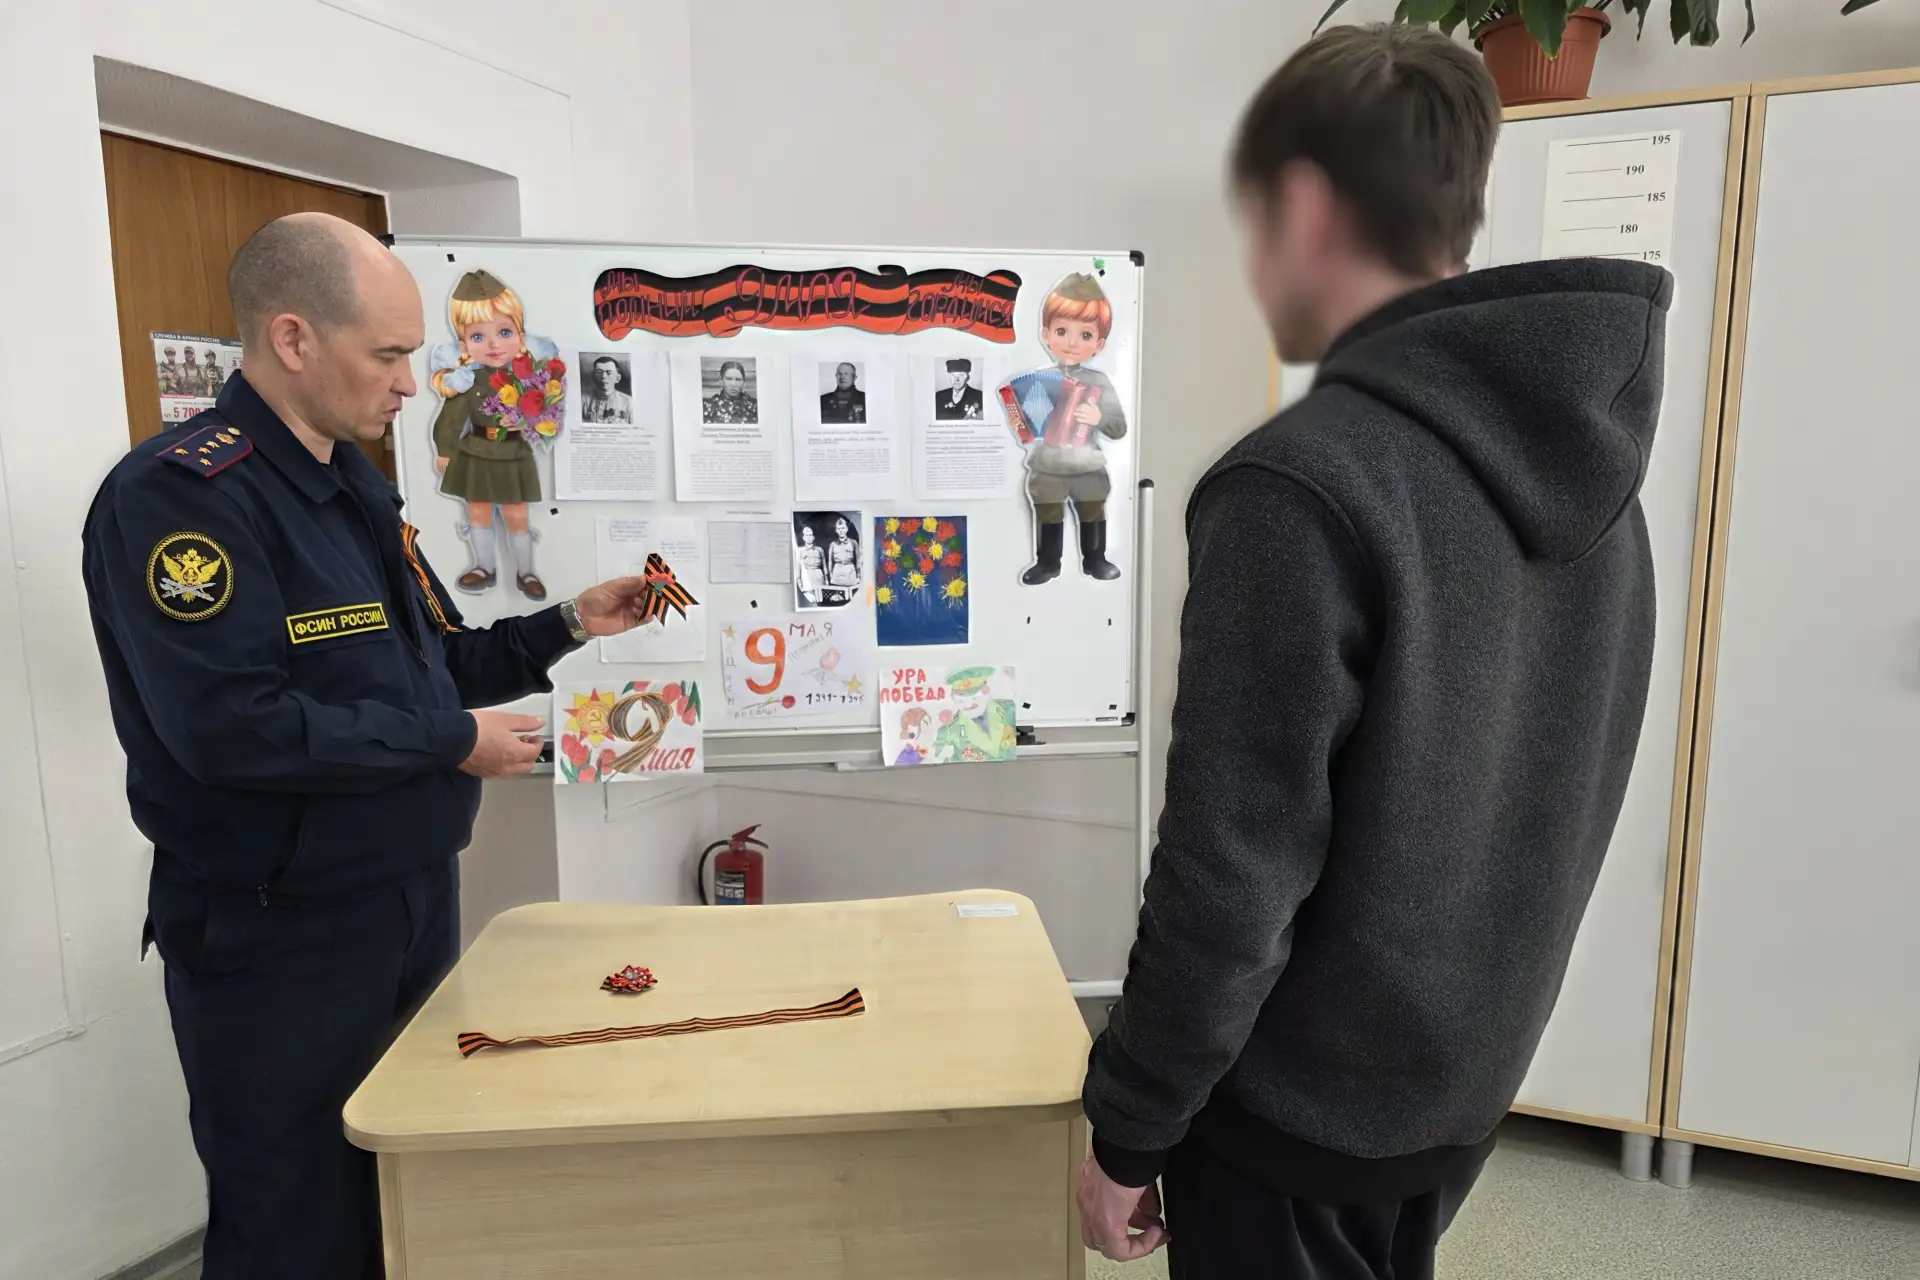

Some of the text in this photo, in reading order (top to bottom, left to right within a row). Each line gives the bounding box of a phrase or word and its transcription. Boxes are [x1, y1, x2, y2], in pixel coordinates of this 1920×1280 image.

[1652, 135, 1671, 145] 195
[1625, 164, 1645, 175] 190
[1647, 192, 1666, 202] 185
[1619, 224, 1638, 234] 180
[1643, 251, 1661, 260] 175
[724, 267, 872, 324] 9 МАЯ
[154, 332, 177, 340] СЛУЖБА
[173, 407, 180, 419] 5
[295, 610, 383, 635] ФСИН РОССИИ
[744, 622, 834, 694] 9 МАЯ
[893, 668, 926, 685] УРА
[880, 686, 946, 704] ПОБЕДА
